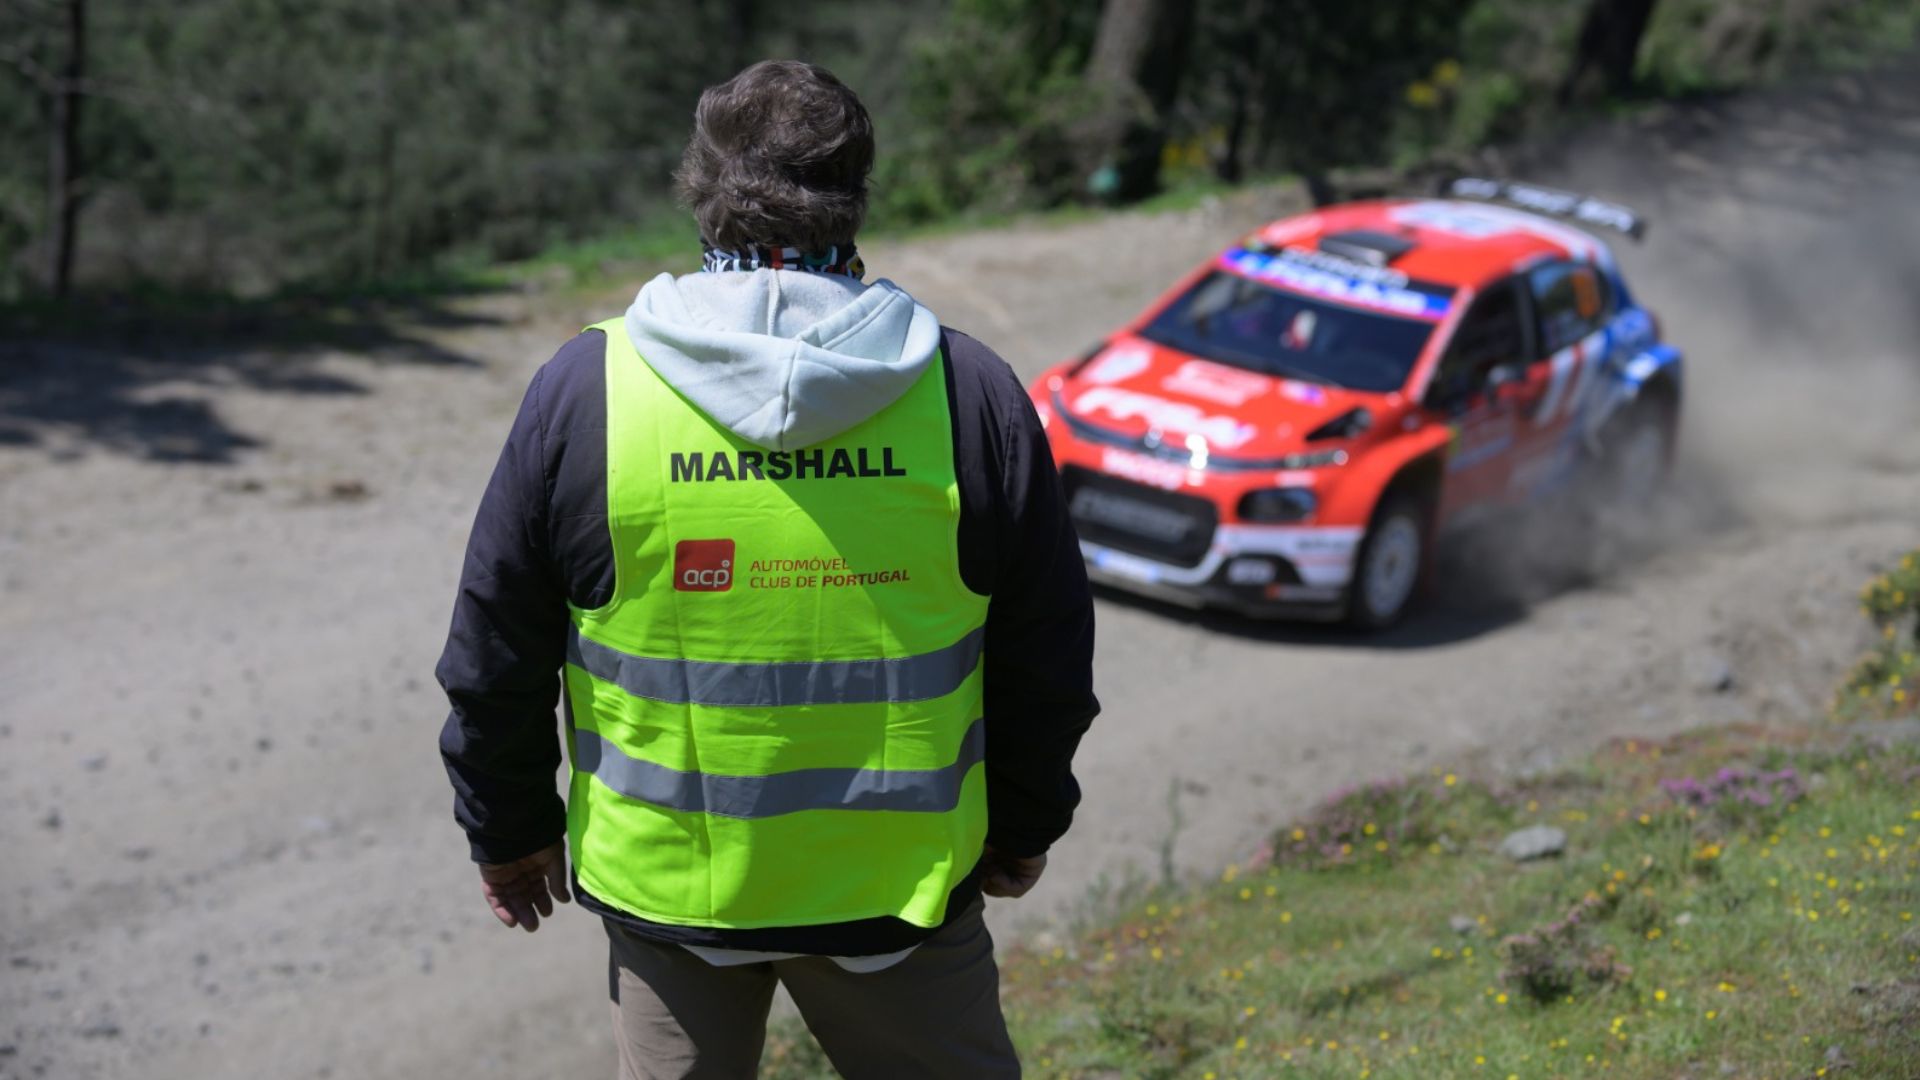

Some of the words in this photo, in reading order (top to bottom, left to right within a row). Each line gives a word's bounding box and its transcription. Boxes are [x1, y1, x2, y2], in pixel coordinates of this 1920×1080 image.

[670, 447, 907, 482] MARSHALL
[750, 556, 849, 572] AUTOMÓVEL
[683, 568, 730, 588] acp
[749, 575, 791, 588] CLUB
[796, 574, 817, 588] DE
[822, 569, 911, 588] PORTUGAL
